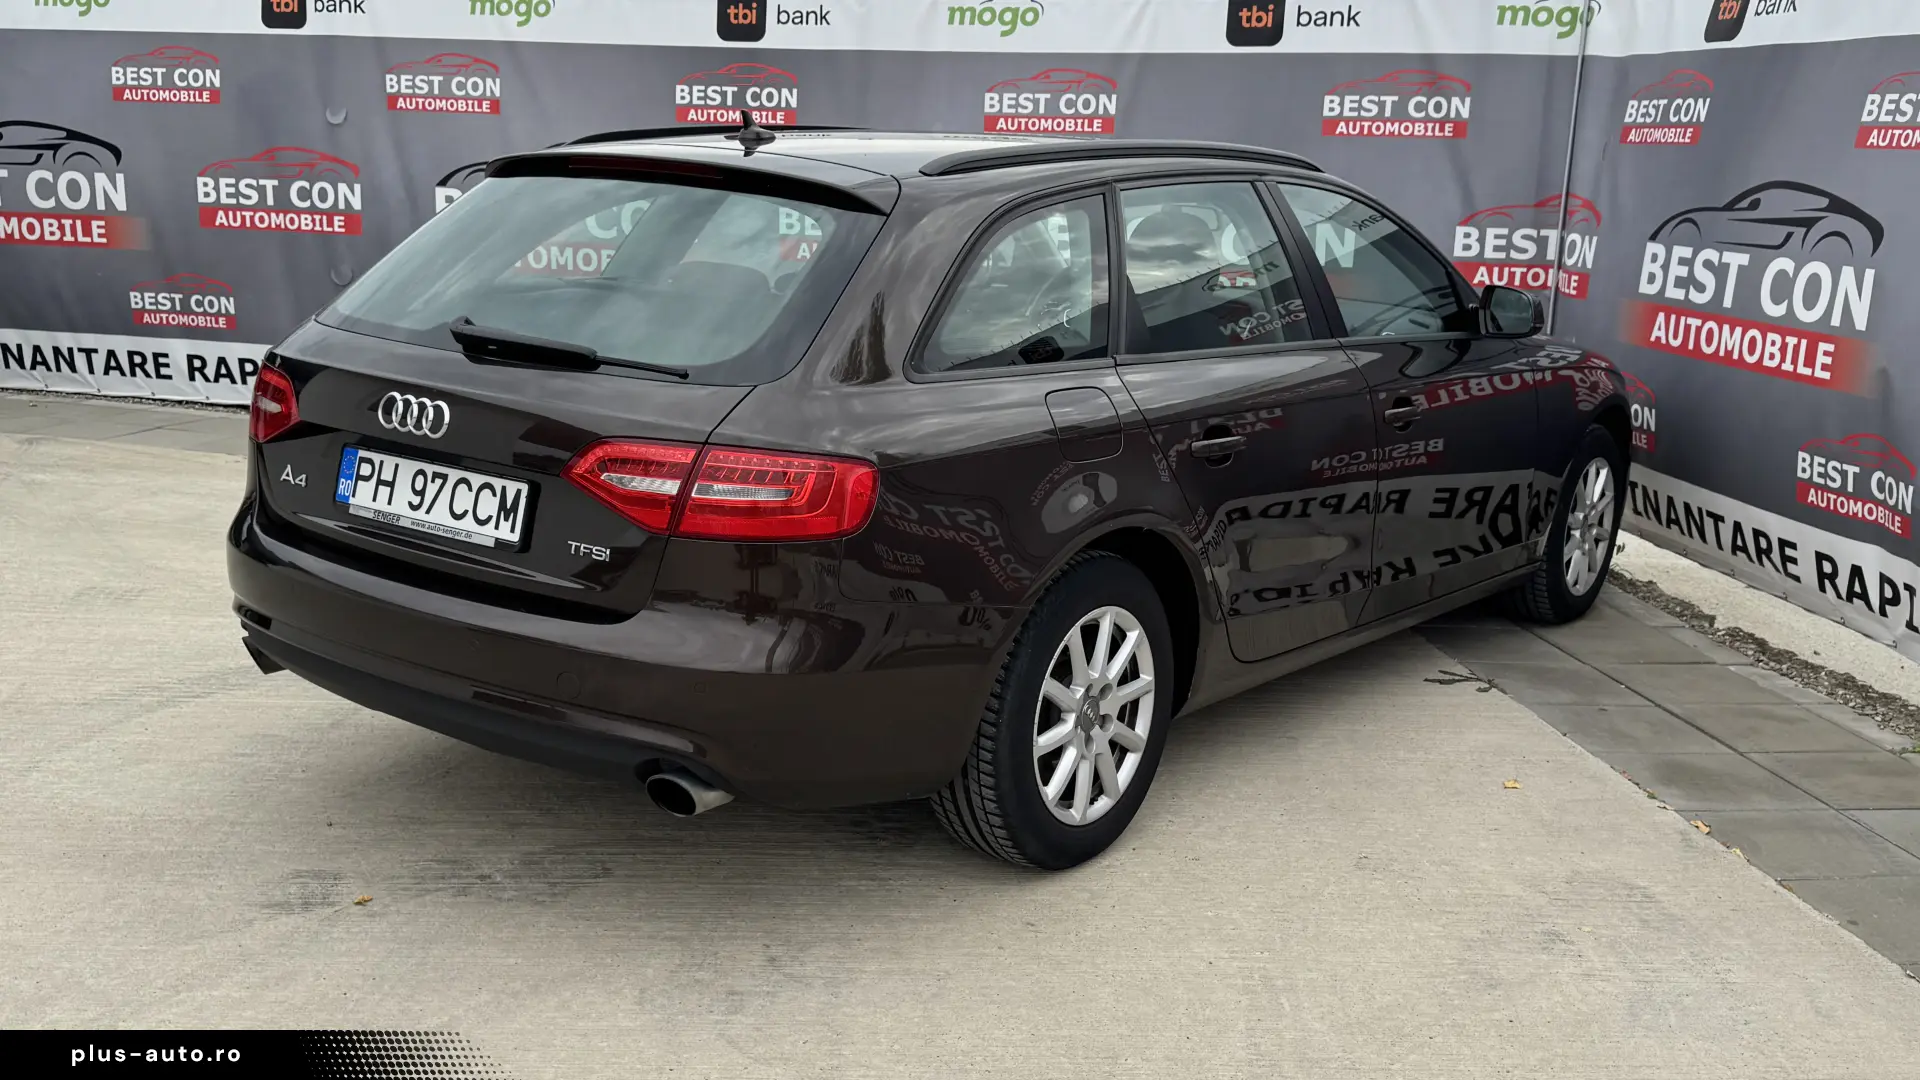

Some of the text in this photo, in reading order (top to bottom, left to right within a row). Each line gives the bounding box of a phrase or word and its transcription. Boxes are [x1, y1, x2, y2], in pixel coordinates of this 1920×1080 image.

[469, 0, 552, 27] mogo
[727, 3, 831, 26] tbi bank
[947, 4, 1040, 37] mogo
[1239, 6, 1361, 28] tbi bank
[111, 66, 221, 88] BEST CON
[385, 74, 501, 97] BEST CON
[123, 89, 211, 103] AUTOMOBILE
[396, 97, 491, 113] AUTOMOBILE
[675, 85, 798, 108] BEST CON
[984, 92, 1117, 115] BEST CON
[1322, 95, 1471, 118] BEST CON
[1860, 93, 1920, 122] BES
[687, 109, 785, 124] AUTOMBILE
[1624, 97, 1710, 124] BEST CON
[996, 117, 1102, 132] AUTOMOBILE
[1335, 121, 1454, 136] AUTOMOBILE
[1626, 127, 1693, 143] AUTOMOBILE
[25, 169, 127, 212] CON
[196, 176, 363, 211] BEST CON
[214, 211, 346, 233] AUTOMOBILE
[1452, 225, 1598, 269] BEST ON
[1638, 241, 1876, 331] BEST CON
[129, 291, 236, 315] BEST CON
[142, 313, 227, 329] AUTOMOBILE
[1649, 312, 1836, 380] AUTOMOBILE
[0, 342, 173, 380] NANTARE
[280, 464, 307, 488] A4
[338, 477, 352, 497] RO
[351, 455, 400, 506] PH
[1797, 450, 1914, 514] BEST CON
[1806, 487, 1903, 535] AUTOMOBILE
[372, 510, 473, 540] SENGER www.auto-senger.de
[568, 540, 611, 562] TFSI
